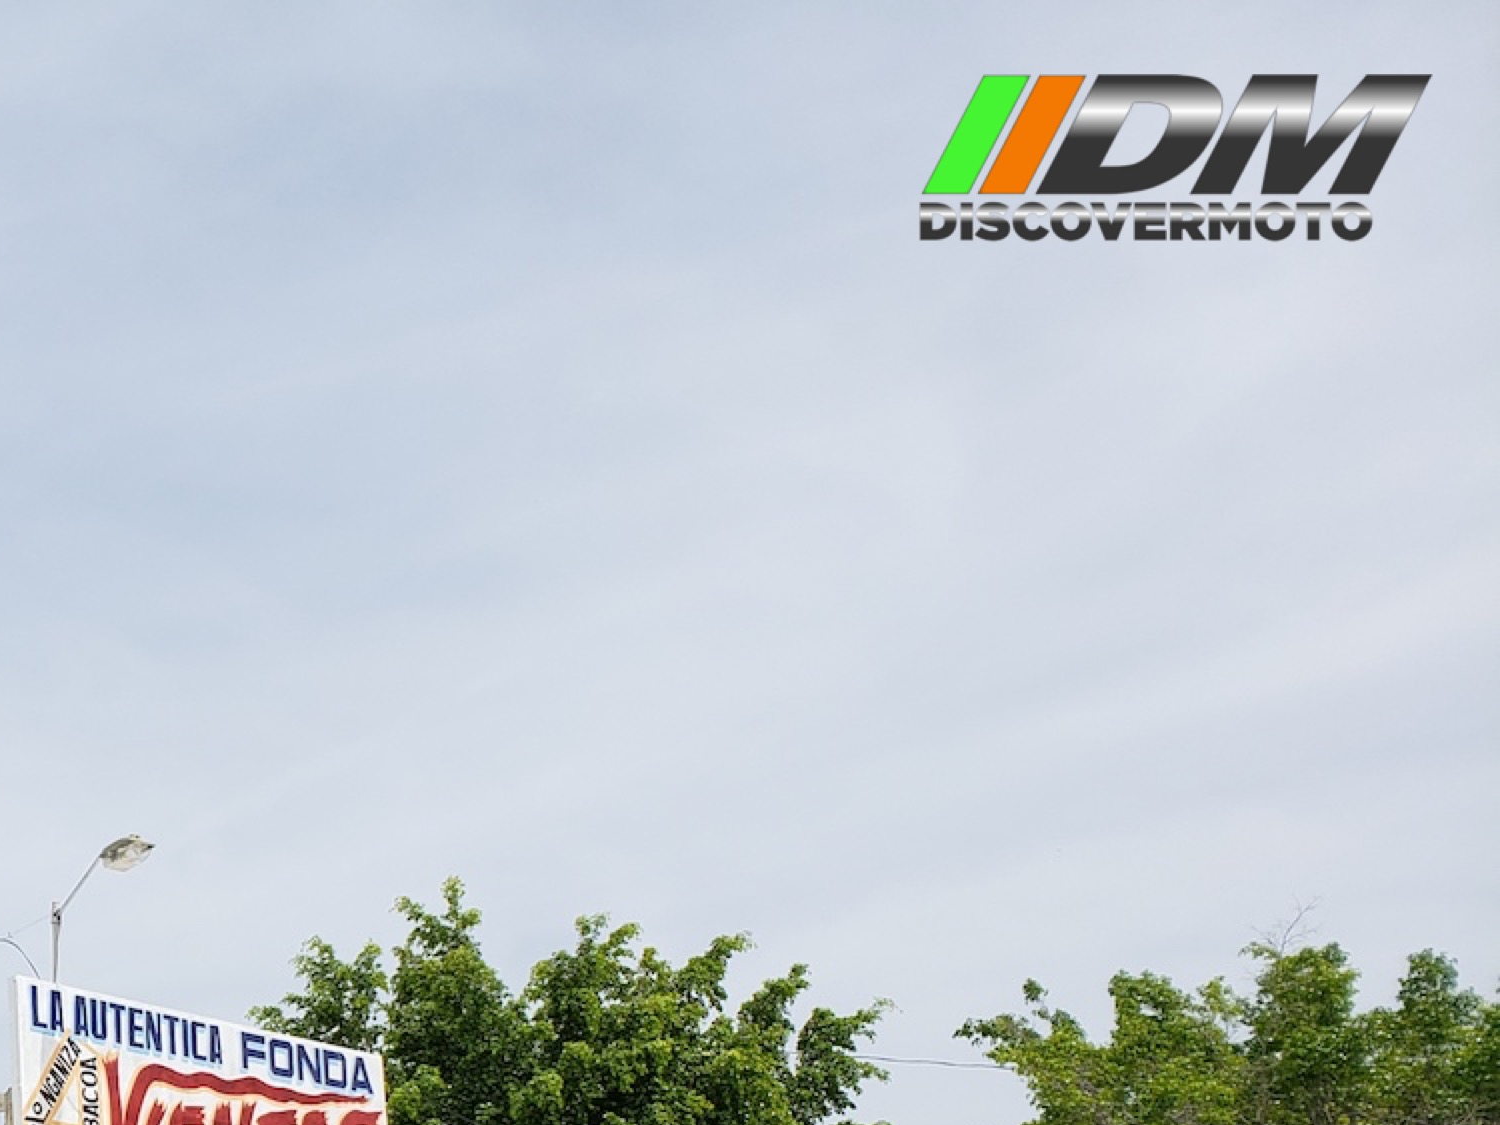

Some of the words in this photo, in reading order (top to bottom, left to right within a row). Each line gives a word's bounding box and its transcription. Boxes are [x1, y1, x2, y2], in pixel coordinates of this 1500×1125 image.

[30, 985, 64, 1032] LA
[74, 995, 223, 1064] AUTENTICA
[240, 1031, 373, 1094] FONDA
